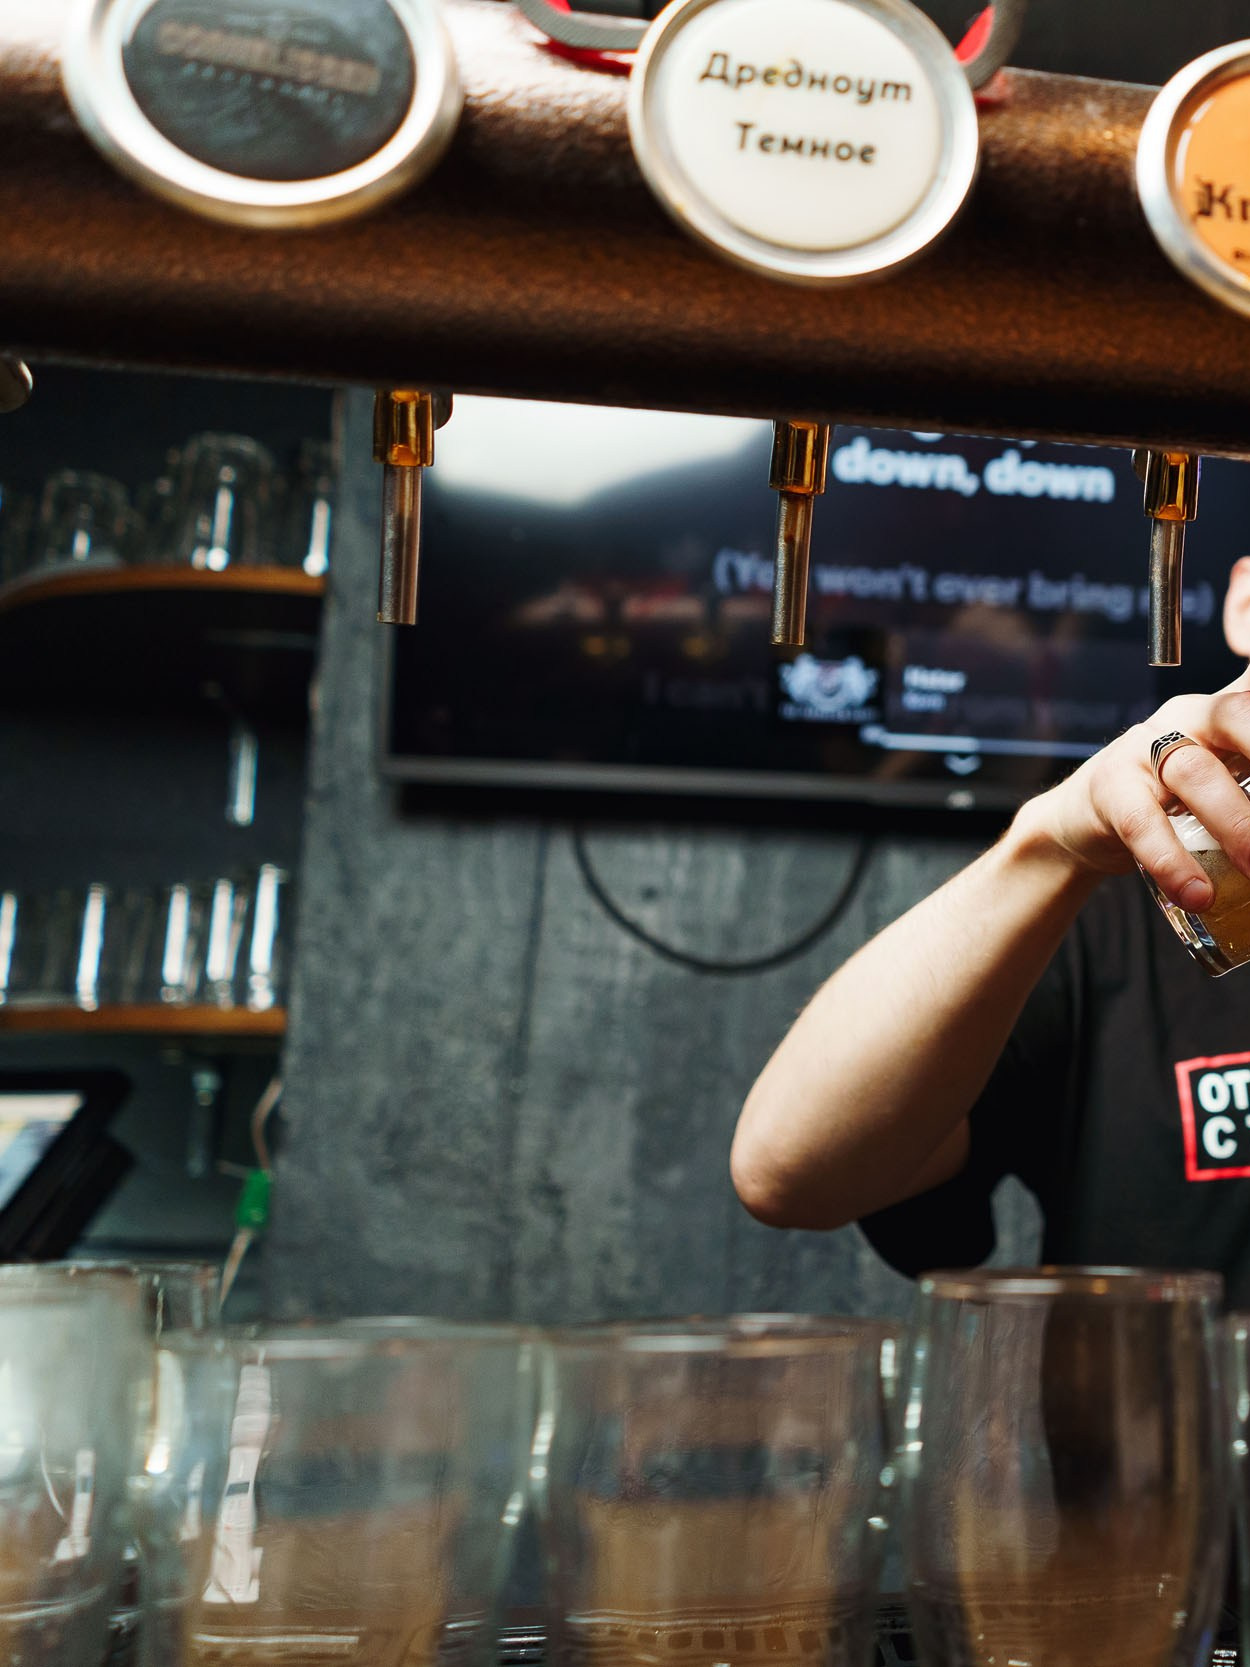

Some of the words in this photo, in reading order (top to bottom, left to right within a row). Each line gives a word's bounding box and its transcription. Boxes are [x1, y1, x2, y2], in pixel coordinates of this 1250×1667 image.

[699, 52, 913, 104] Дредноут
[736, 121, 878, 165] Темное
[831, 436, 980, 497] down,
[983, 448, 1115, 502] down
[815, 563, 930, 601] won't
[932, 574, 1023, 603] ever
[1026, 570, 1135, 622] bring
[1202, 1116, 1237, 1160] С
